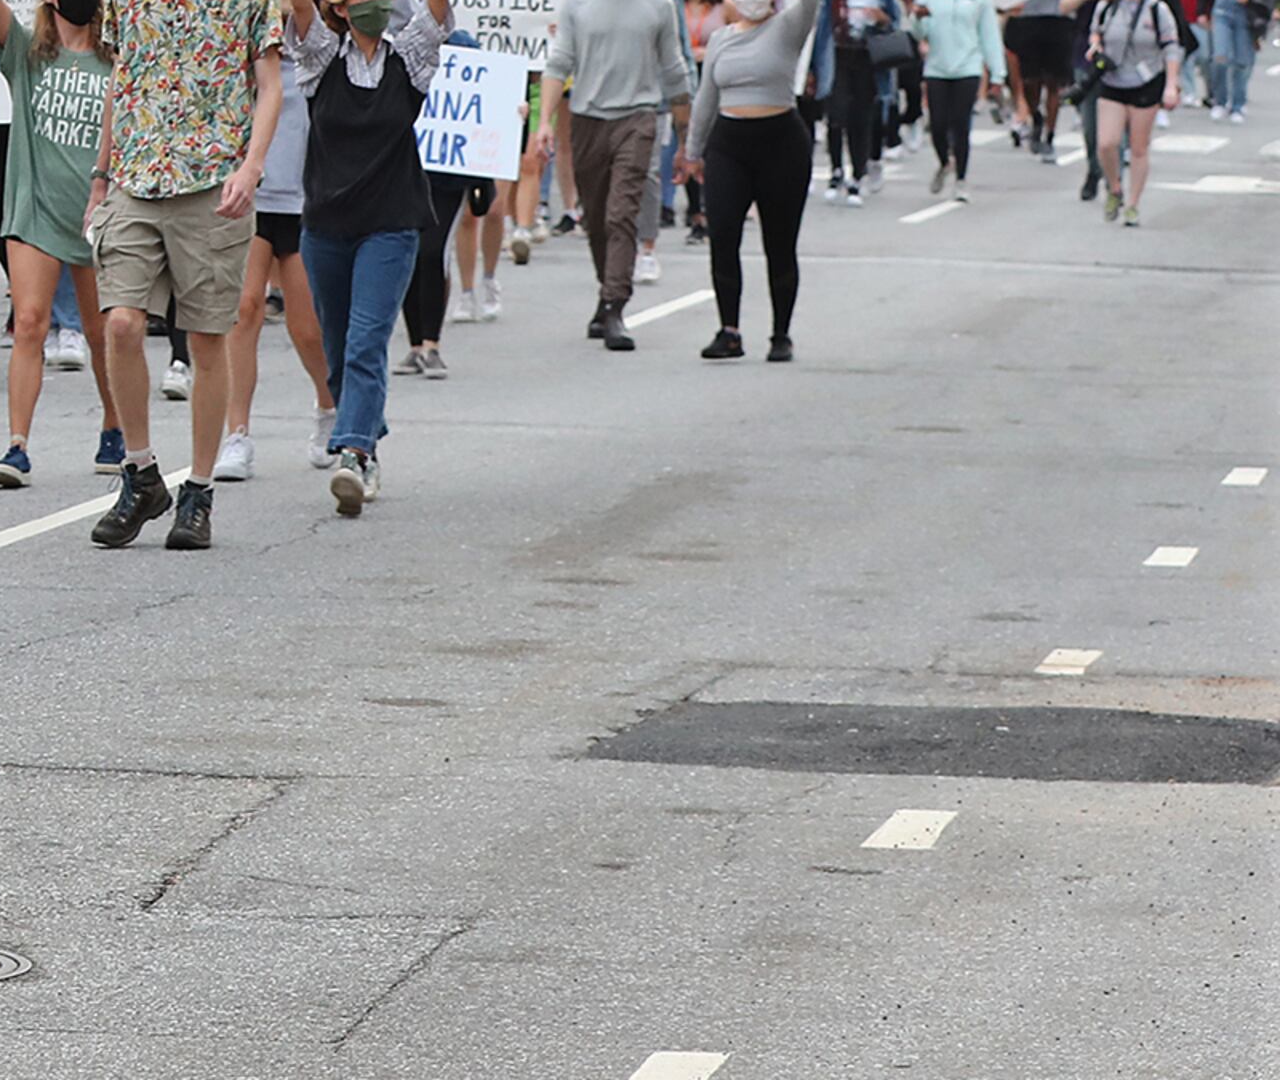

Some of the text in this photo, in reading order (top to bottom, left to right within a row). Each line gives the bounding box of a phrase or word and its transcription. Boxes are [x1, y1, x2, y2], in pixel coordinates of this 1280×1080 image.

[477, 16, 511, 29] FOR
[40, 67, 111, 99] ATHENS
[443, 53, 488, 83] for
